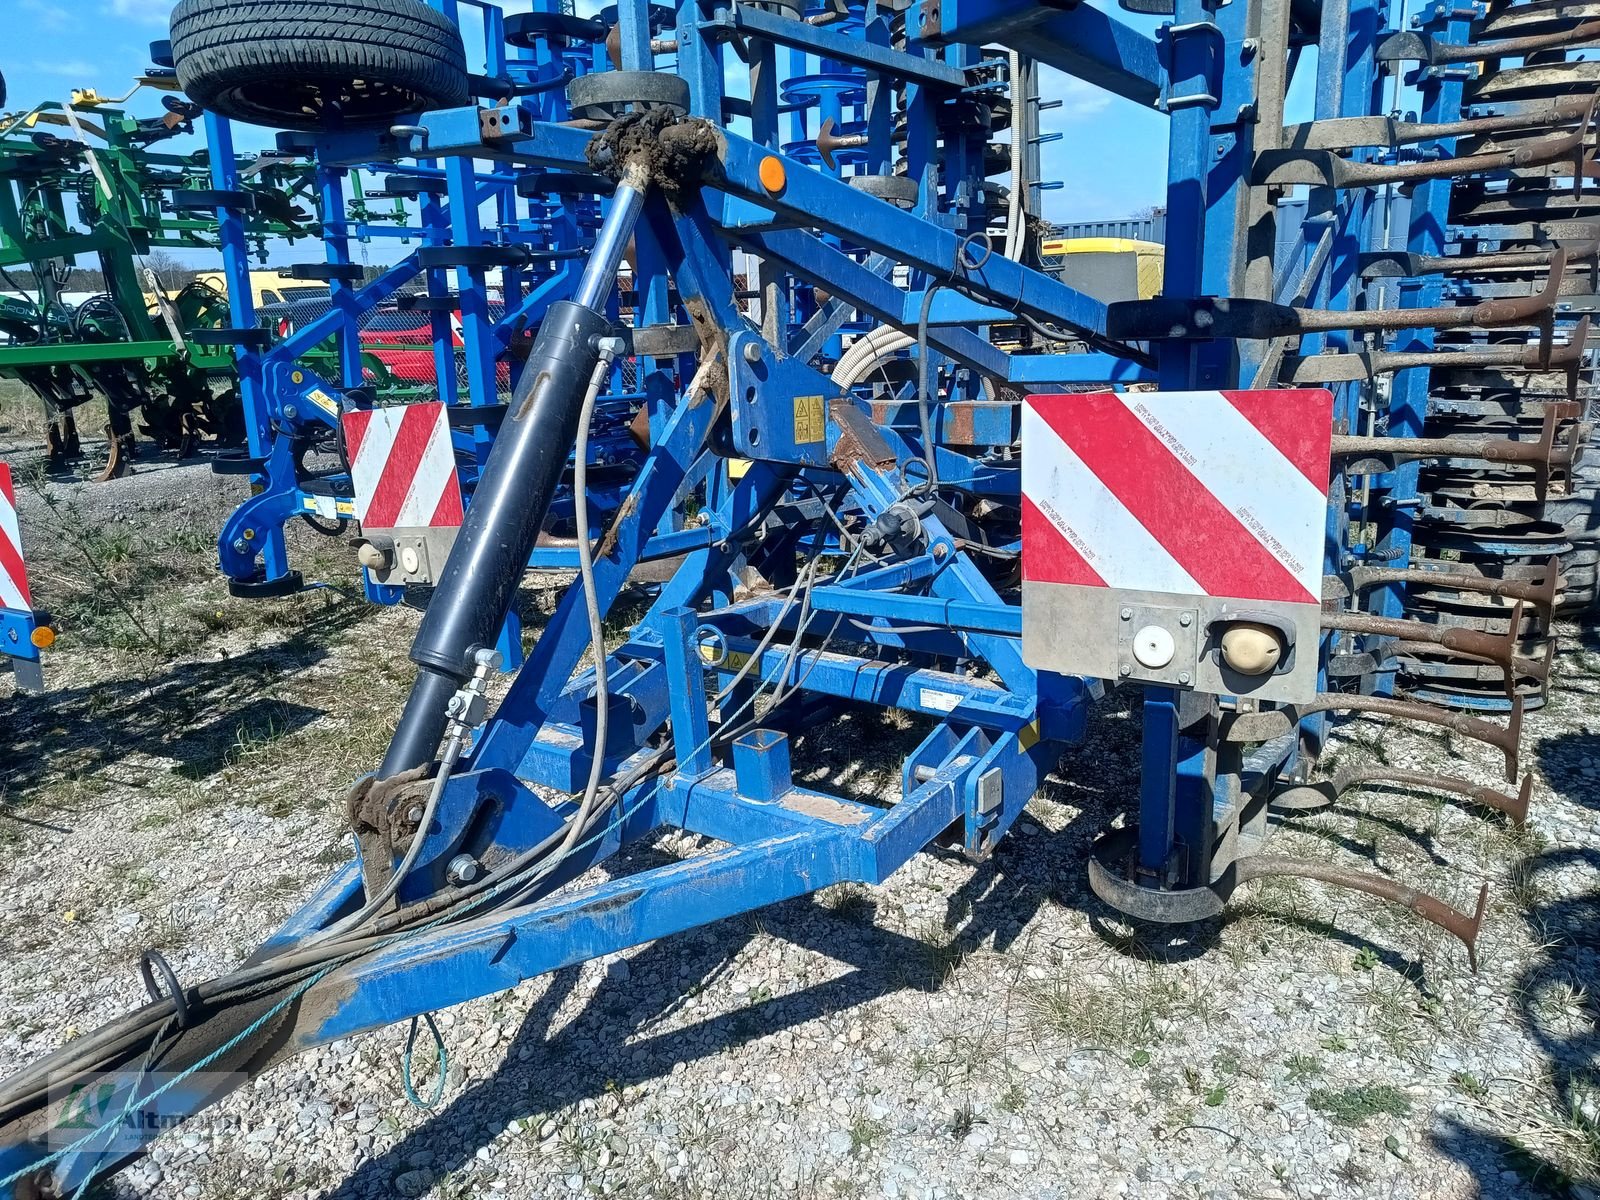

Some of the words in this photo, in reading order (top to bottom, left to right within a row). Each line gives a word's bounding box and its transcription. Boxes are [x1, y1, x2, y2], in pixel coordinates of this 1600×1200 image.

[1133, 405, 1142, 414] DIN
[1188, 454, 1197, 463] DIN
[1039, 502, 1047, 510] DIN
[1235, 508, 1245, 518] DIN
[1087, 549, 1095, 558] DIN
[1294, 562, 1304, 571] DIN
